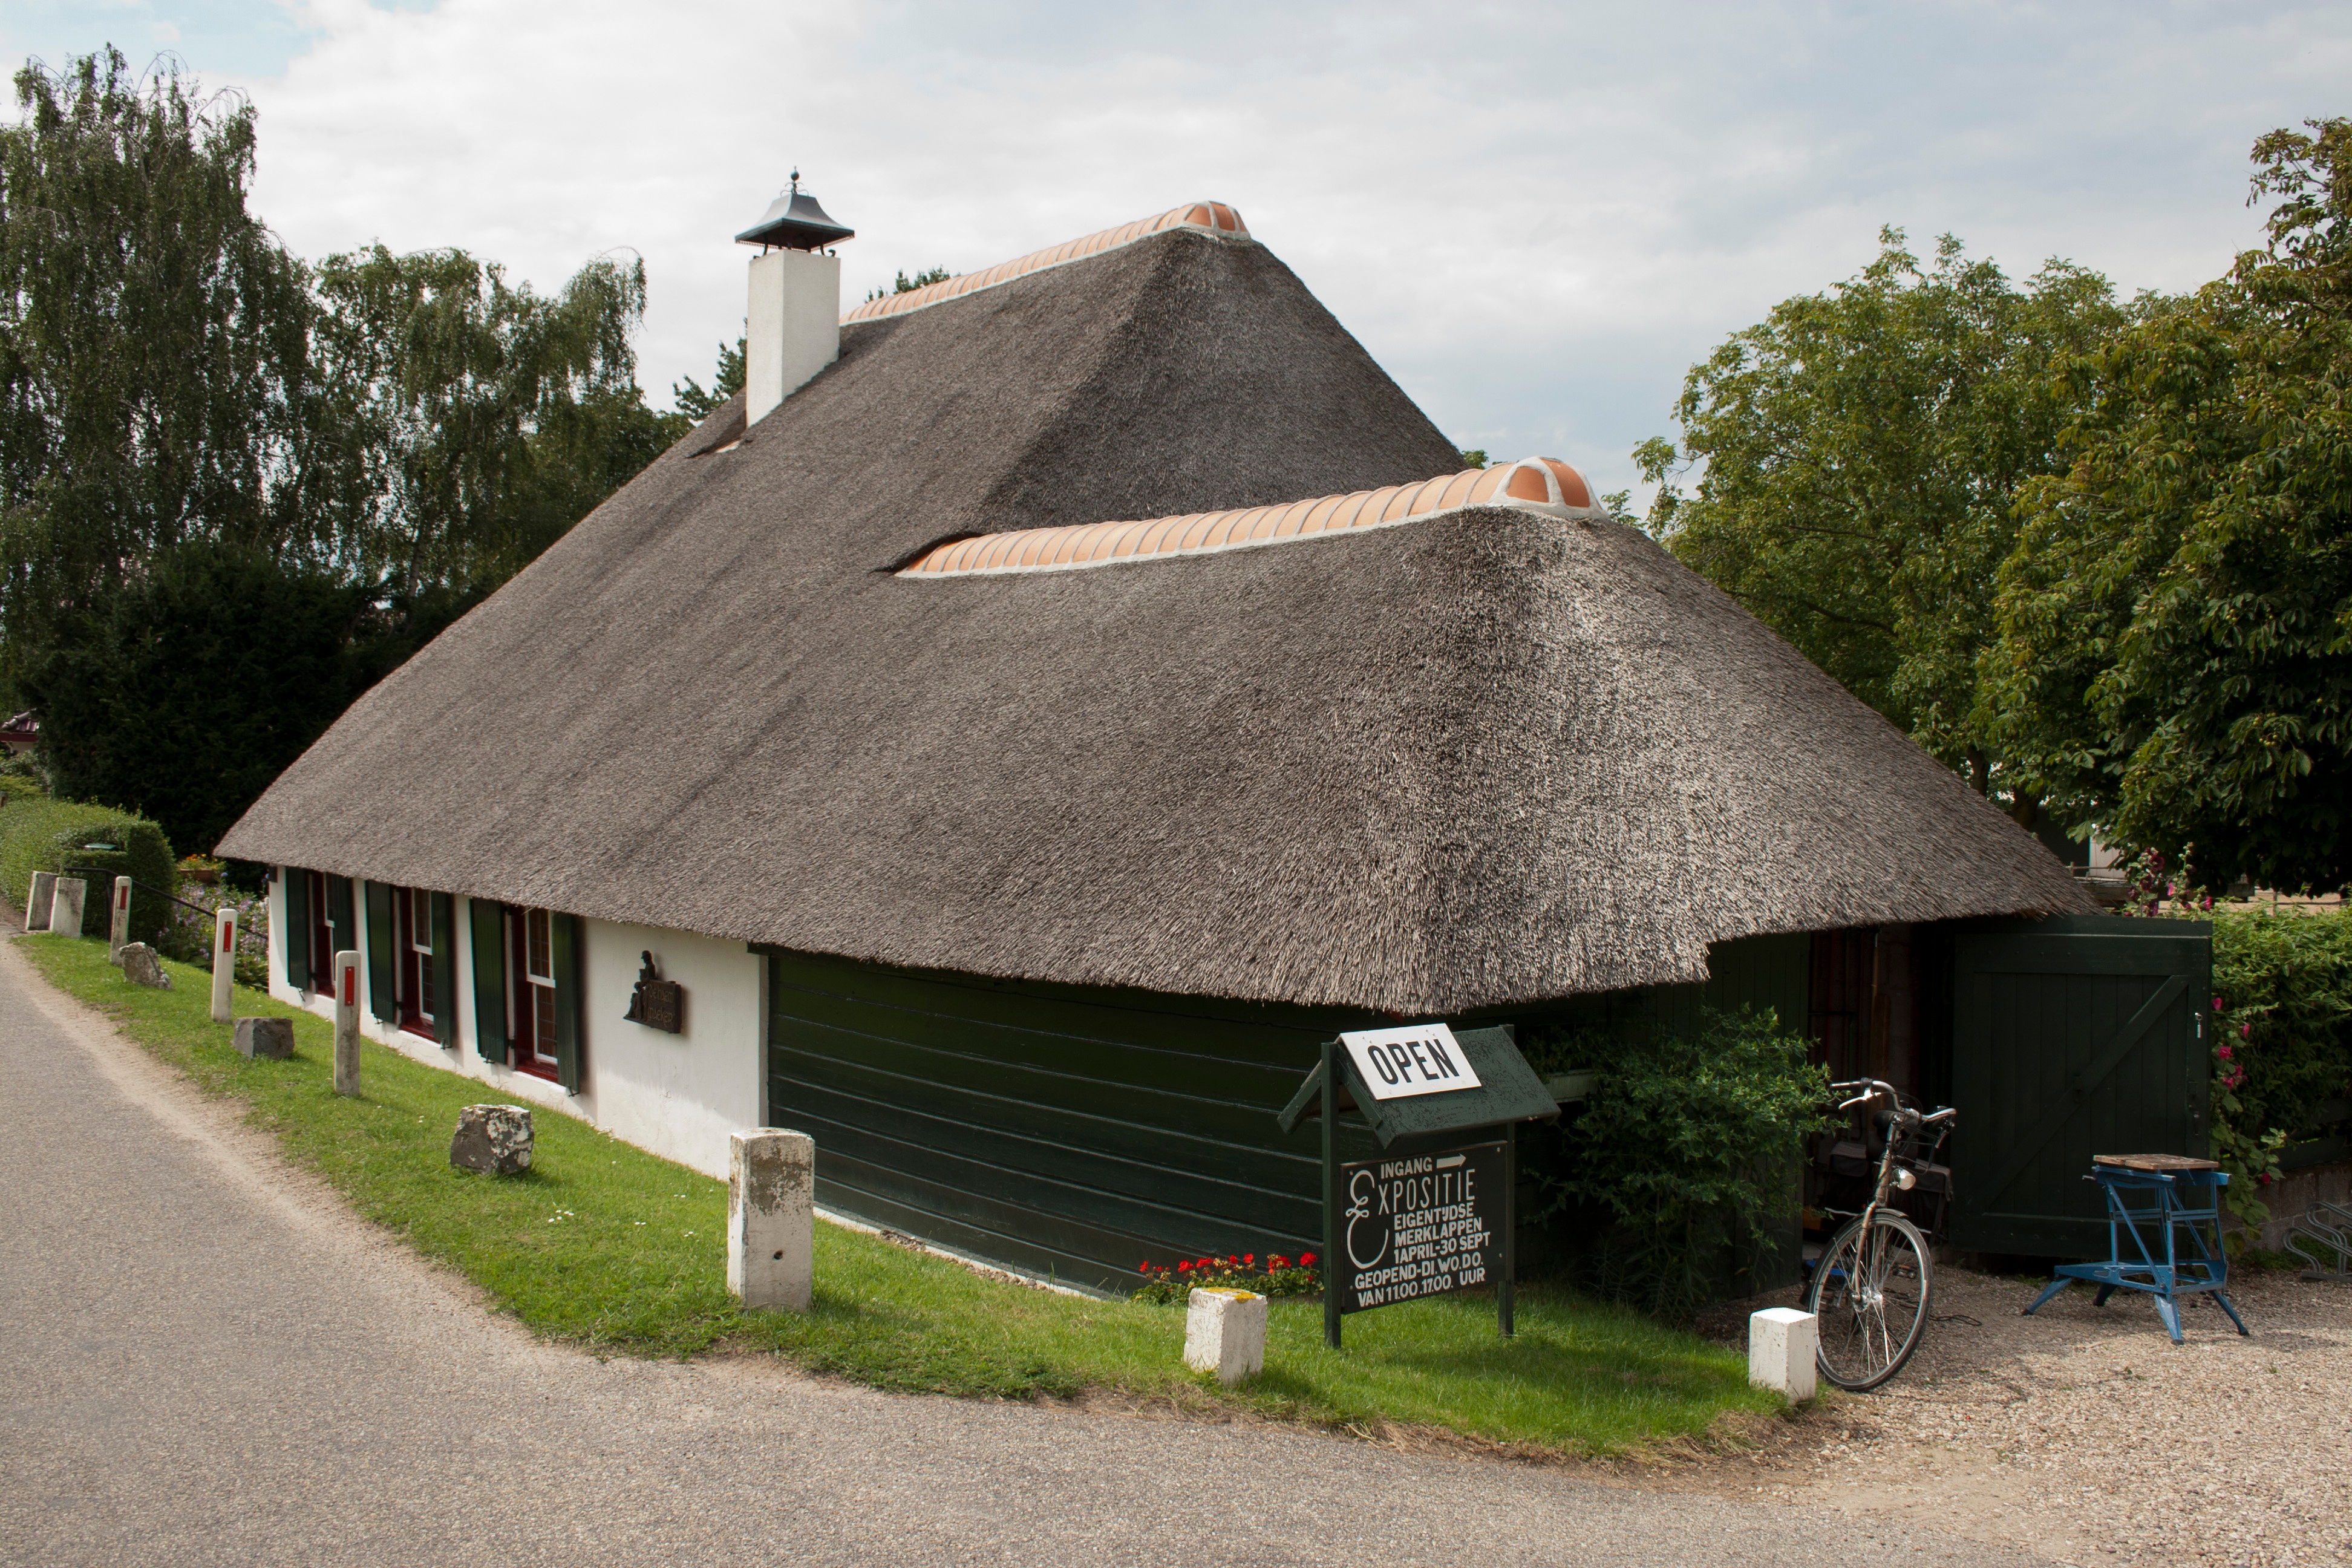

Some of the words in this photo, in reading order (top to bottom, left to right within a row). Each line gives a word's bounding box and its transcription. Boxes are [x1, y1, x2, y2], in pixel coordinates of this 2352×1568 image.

[1367, 1038, 1460, 1085] OPEN
[1380, 1156, 1432, 1180] INGANG
[1394, 1217, 1482, 1247] MERKLAPPEN
[1459, 1231, 1491, 1251] SEPT
[1357, 1288, 1384, 1307] VAN
[1459, 1267, 1486, 1286] UUR
